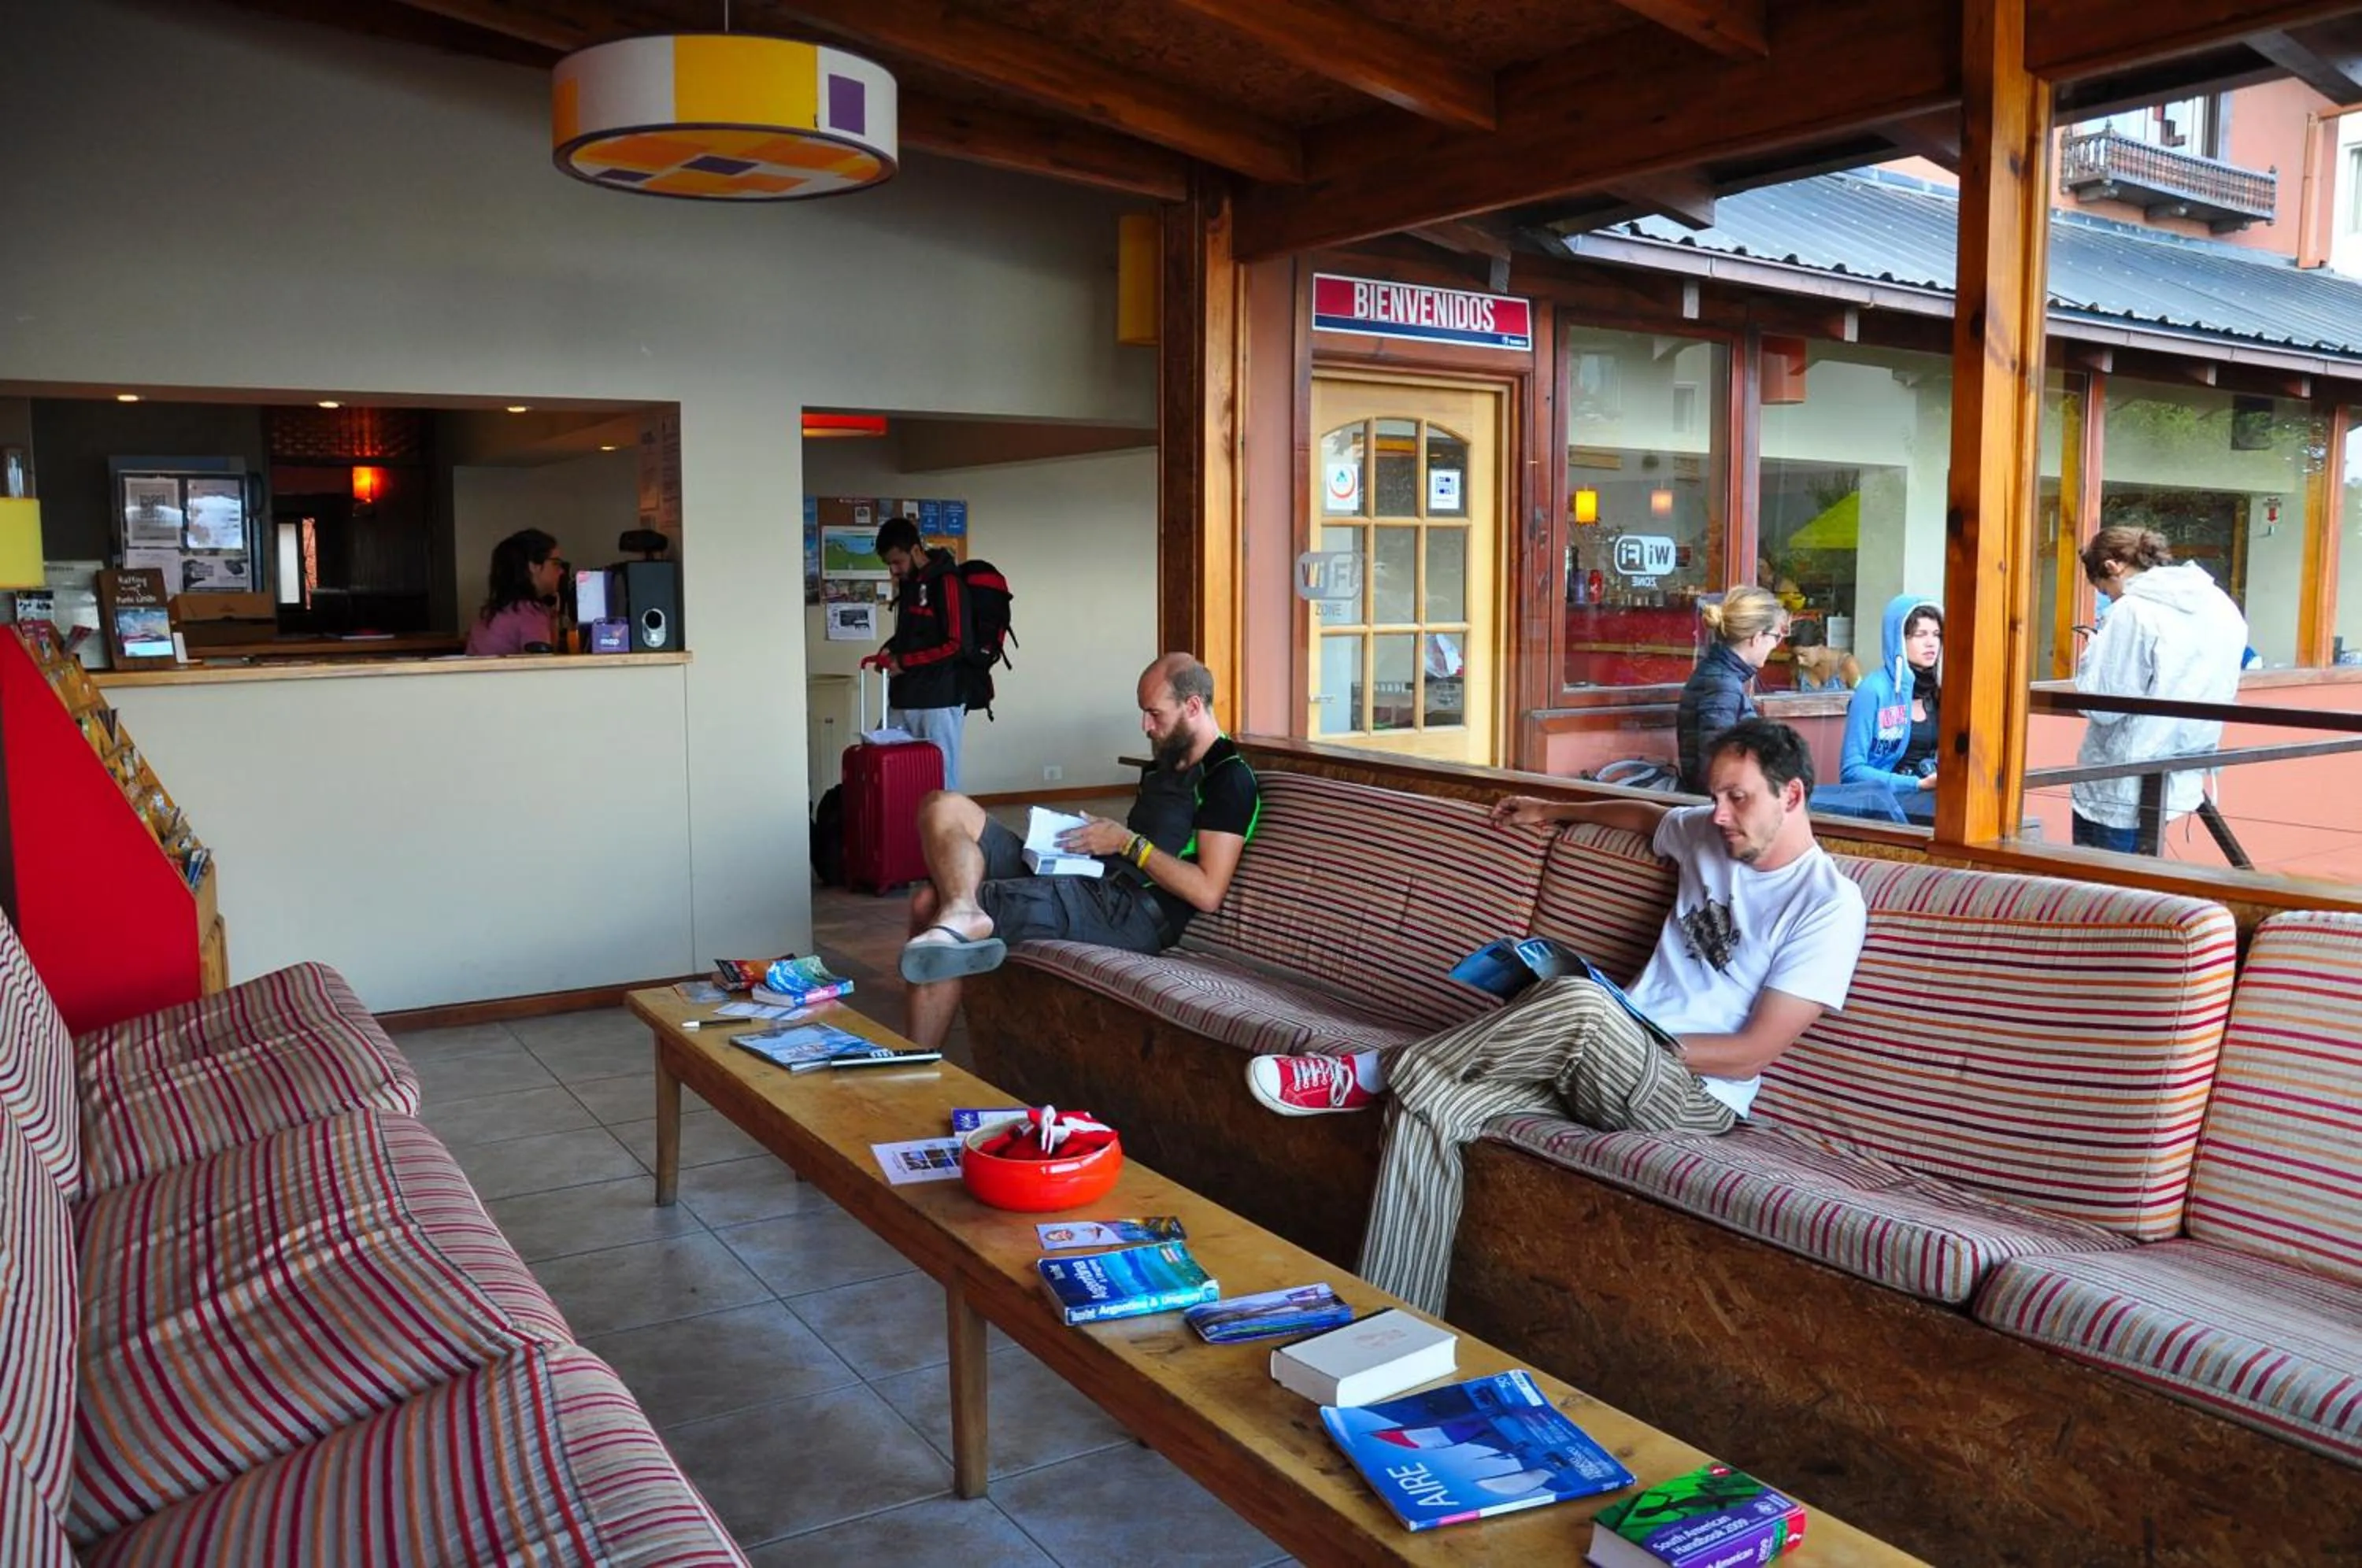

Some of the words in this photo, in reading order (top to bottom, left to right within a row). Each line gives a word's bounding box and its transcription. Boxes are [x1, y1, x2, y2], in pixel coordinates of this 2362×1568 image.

[1353, 281, 1495, 332] BIENVENIDOS
[1386, 1462, 1461, 1506] AIRE
[1653, 1535, 1686, 1551] South
[1683, 1515, 1732, 1537] American
